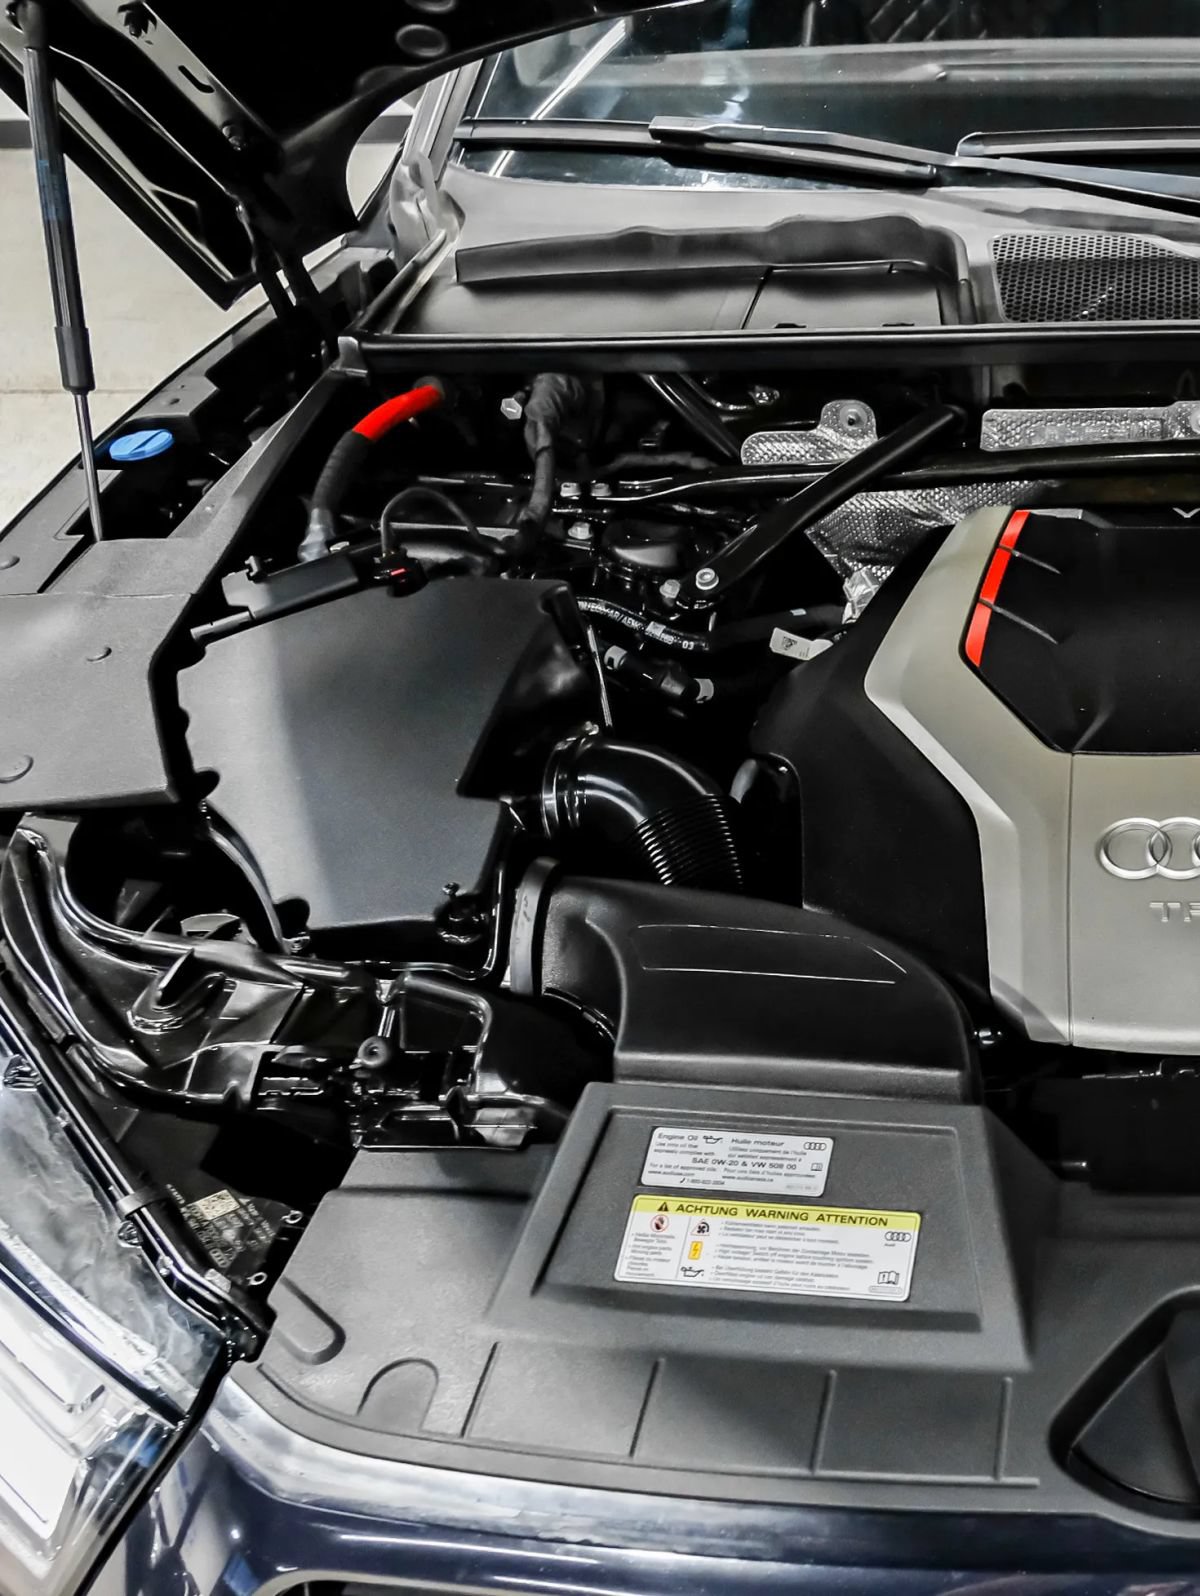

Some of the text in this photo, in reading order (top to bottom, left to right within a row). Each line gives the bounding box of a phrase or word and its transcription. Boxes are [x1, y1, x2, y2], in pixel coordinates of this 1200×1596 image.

[658, 1133, 685, 1141] Engine
[675, 1203, 888, 1227] ACHTUNG WARNING ATTENTION
